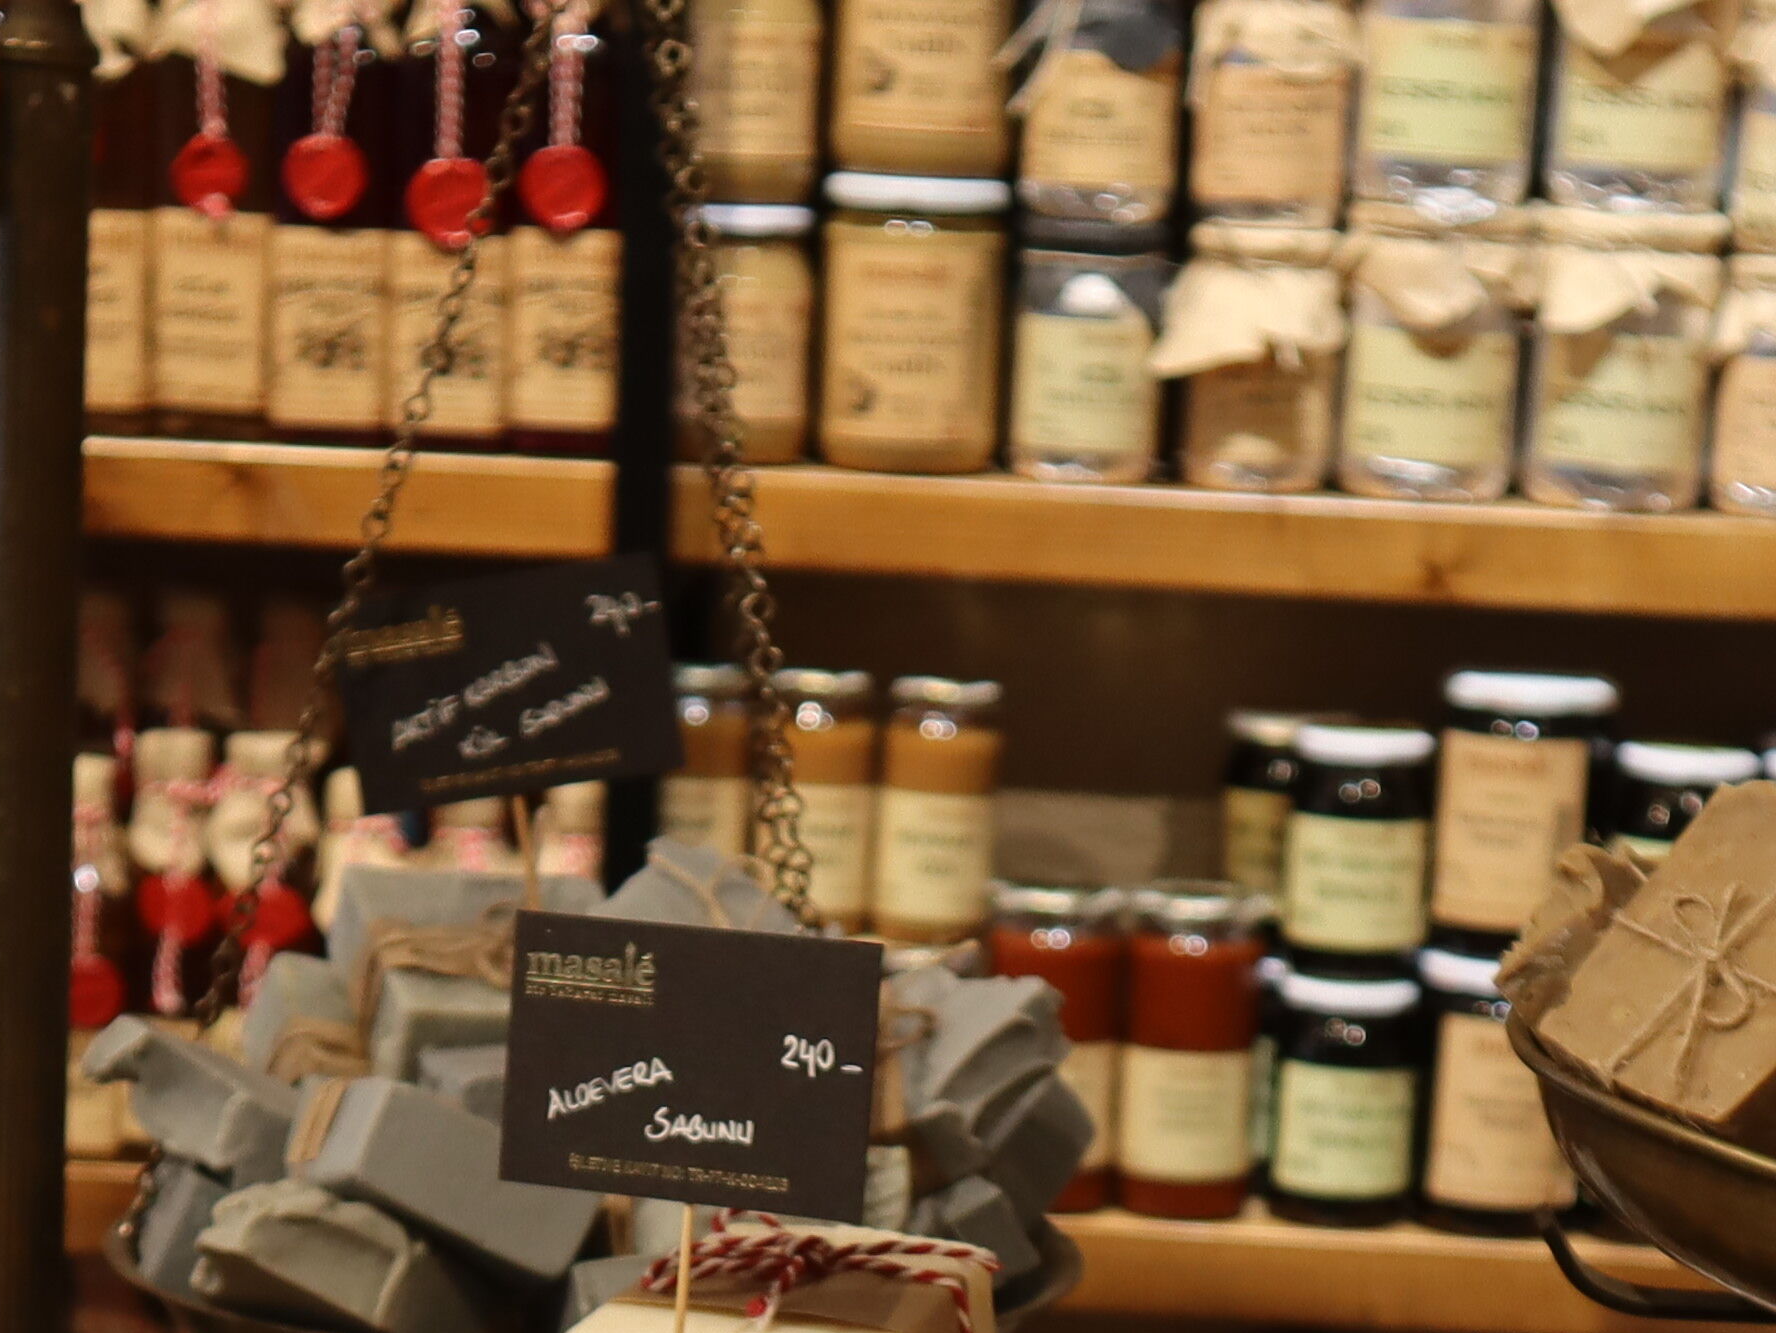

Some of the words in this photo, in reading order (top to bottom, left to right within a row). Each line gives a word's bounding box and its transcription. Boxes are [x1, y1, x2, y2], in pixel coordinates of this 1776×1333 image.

[526, 941, 656, 987] masalé
[547, 1056, 674, 1120] ALOEVERA
[644, 1106, 755, 1146] SABUNU
